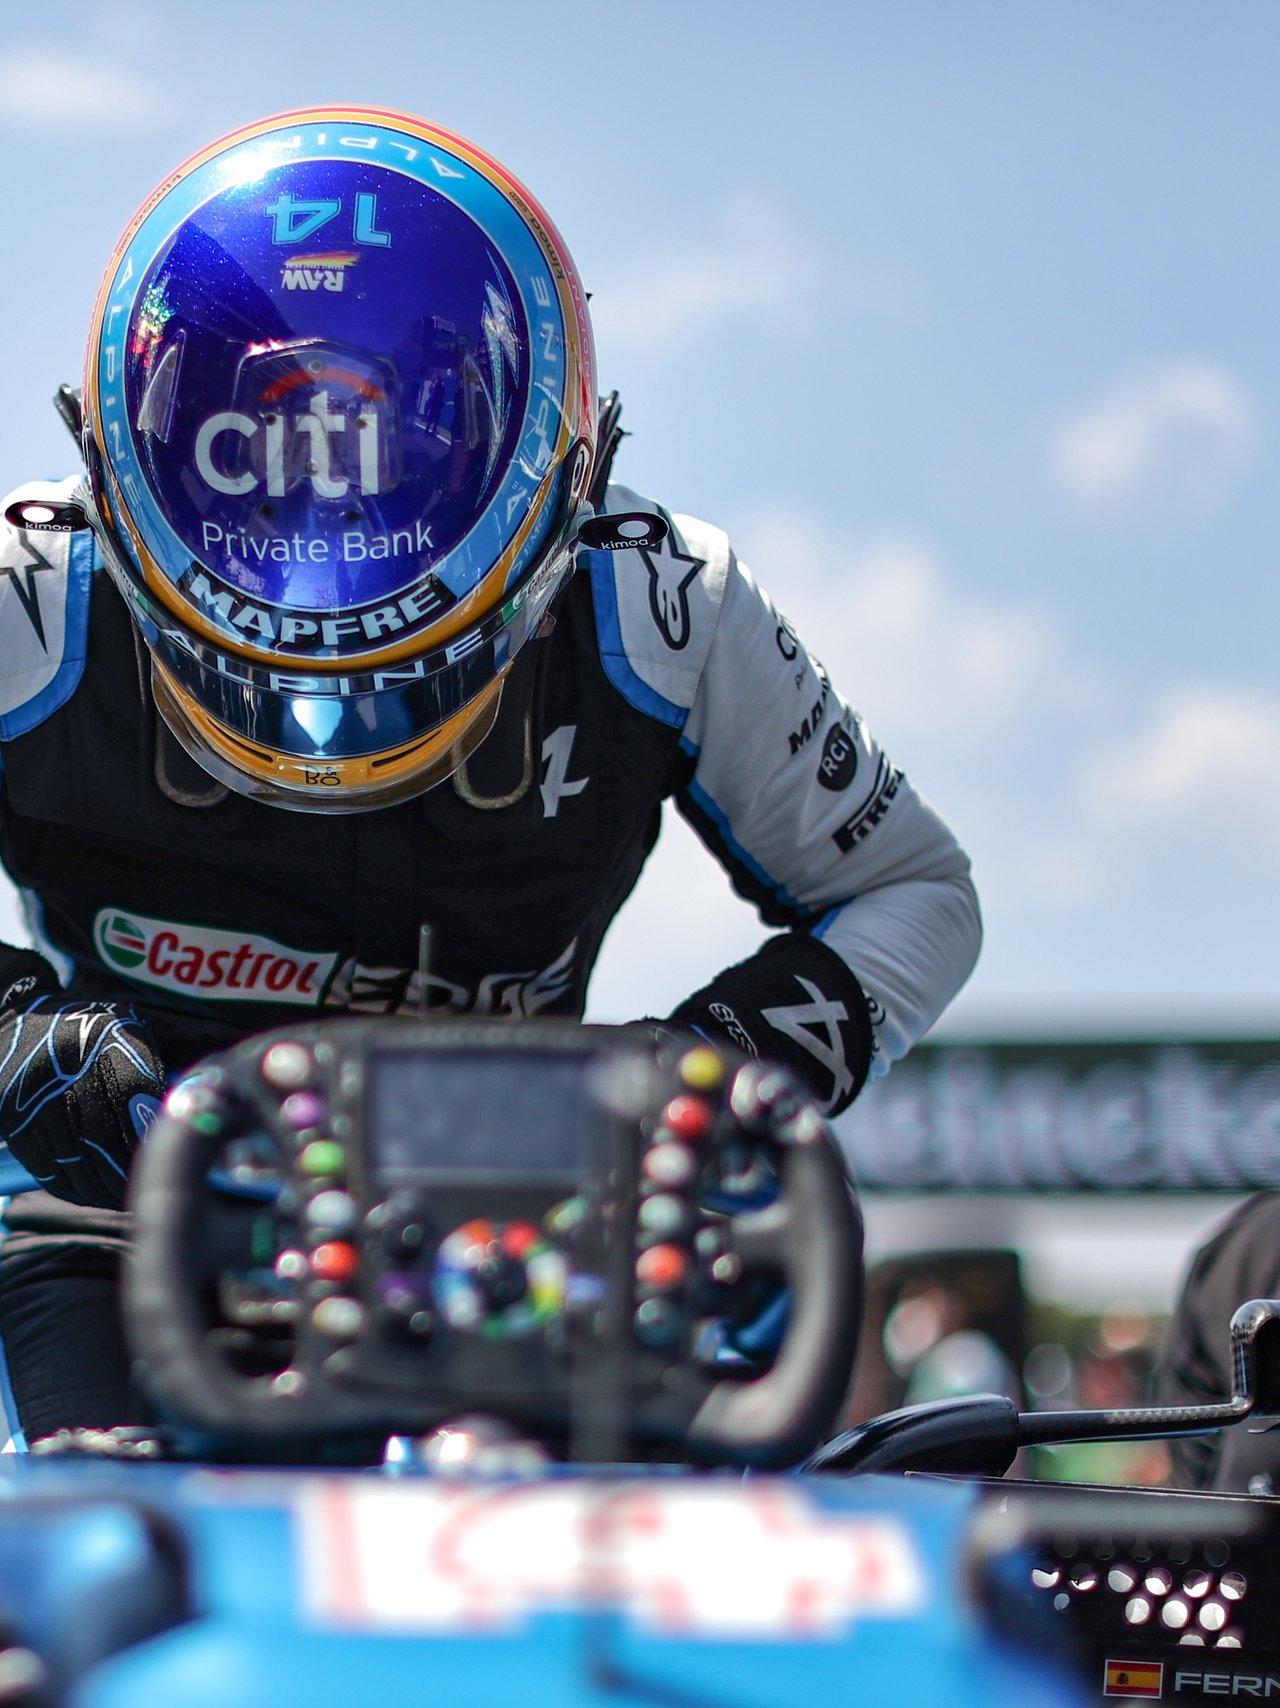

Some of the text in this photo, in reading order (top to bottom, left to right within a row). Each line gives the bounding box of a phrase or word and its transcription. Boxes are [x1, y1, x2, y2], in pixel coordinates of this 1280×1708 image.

[263, 192, 392, 248] 14
[102, 255, 141, 508] ALPINE
[194, 390, 381, 498] citi
[25, 521, 72, 532] kimoa
[201, 521, 437, 563] Private Bank
[601, 538, 649, 550] kimoa
[187, 572, 443, 646] MAPFRE
[163, 627, 484, 695] ALPINE
[821, 739, 849, 777] RCI
[147, 931, 318, 992] Castrol
